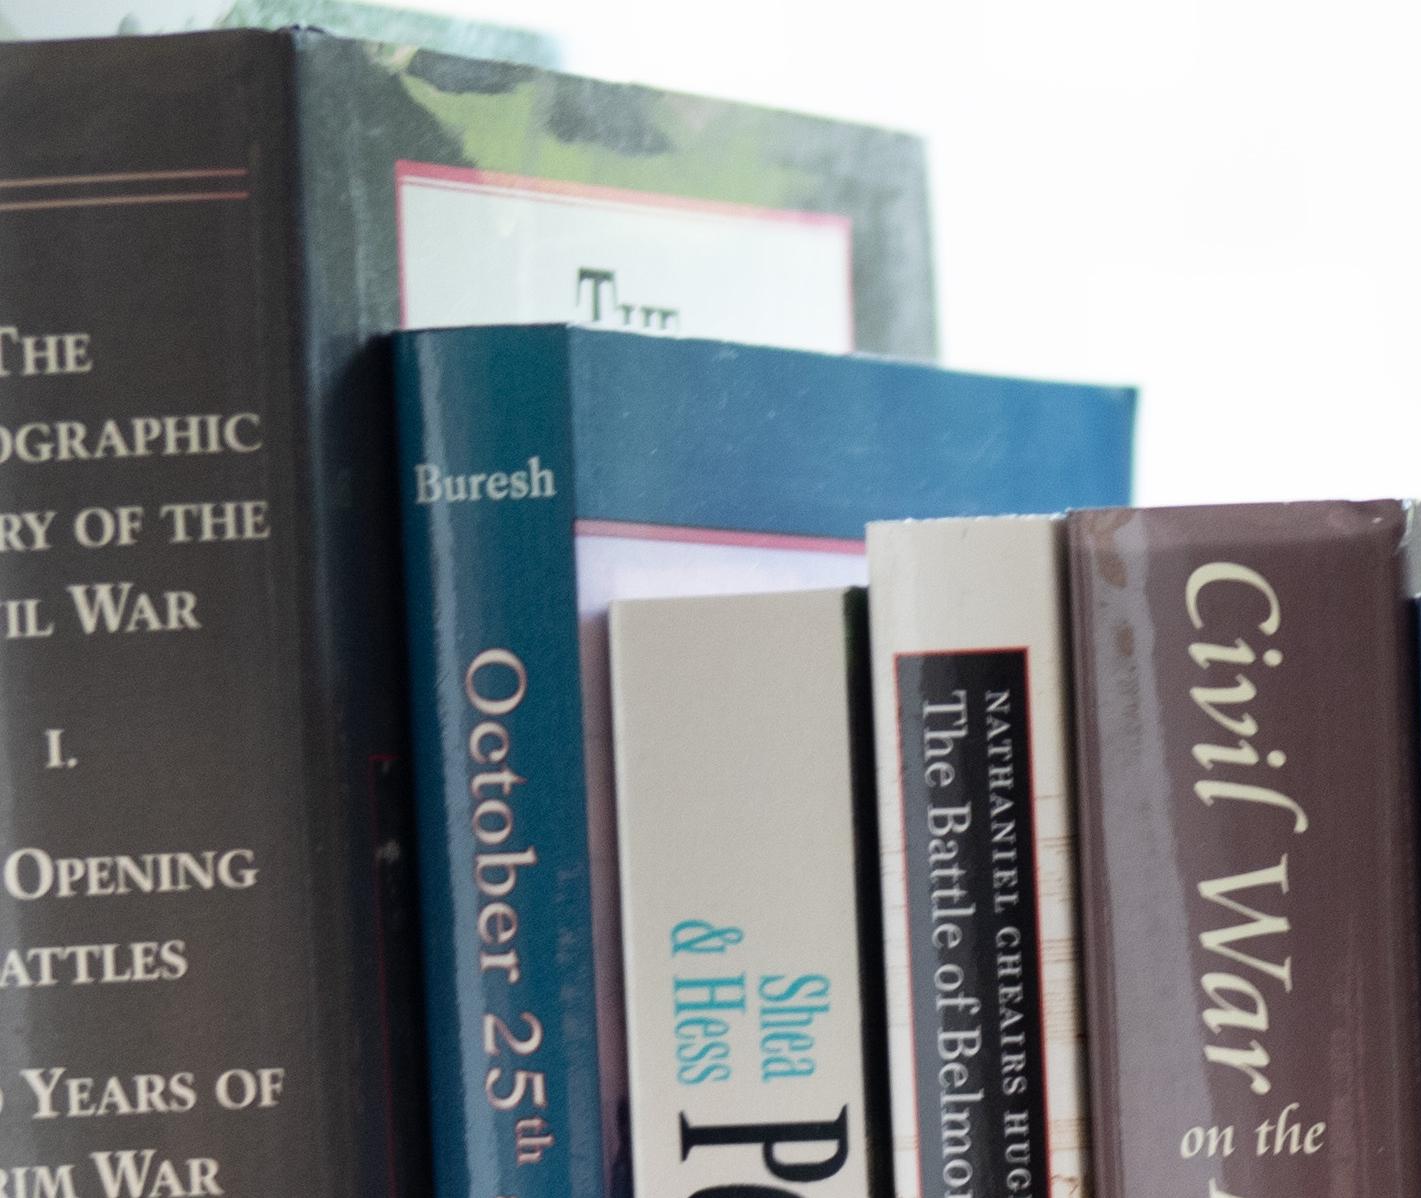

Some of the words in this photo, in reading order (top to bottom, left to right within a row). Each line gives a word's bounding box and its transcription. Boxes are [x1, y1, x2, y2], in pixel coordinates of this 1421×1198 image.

[415, 457, 556, 504] Buresh
[74, 506, 144, 549] OF
[160, 501, 270, 543] THE
[66, 582, 201, 635] WAR
[1185, 561, 1308, 833] Civil
[45, 729, 77, 769] I.
[922, 689, 969, 789] The
[465, 650, 538, 985] October
[985, 689, 1019, 912] NATHANIEL
[4, 848, 259, 900] OPENING
[927, 803, 977, 950] Battle
[668, 920, 744, 955] &
[1198, 854, 1293, 1095] War
[758, 973, 831, 1082] Shea
[933, 962, 982, 1018] of
[996, 925, 1027, 1099] CHEAIRS
[673, 973, 747, 1086] Hess
[20, 1067, 197, 1120] YEARS
[215, 1068, 285, 1110] OF
[482, 1011, 556, 1166] 25th
[1180, 1119, 1235, 1160] on
[1255, 1103, 1327, 1157] the
